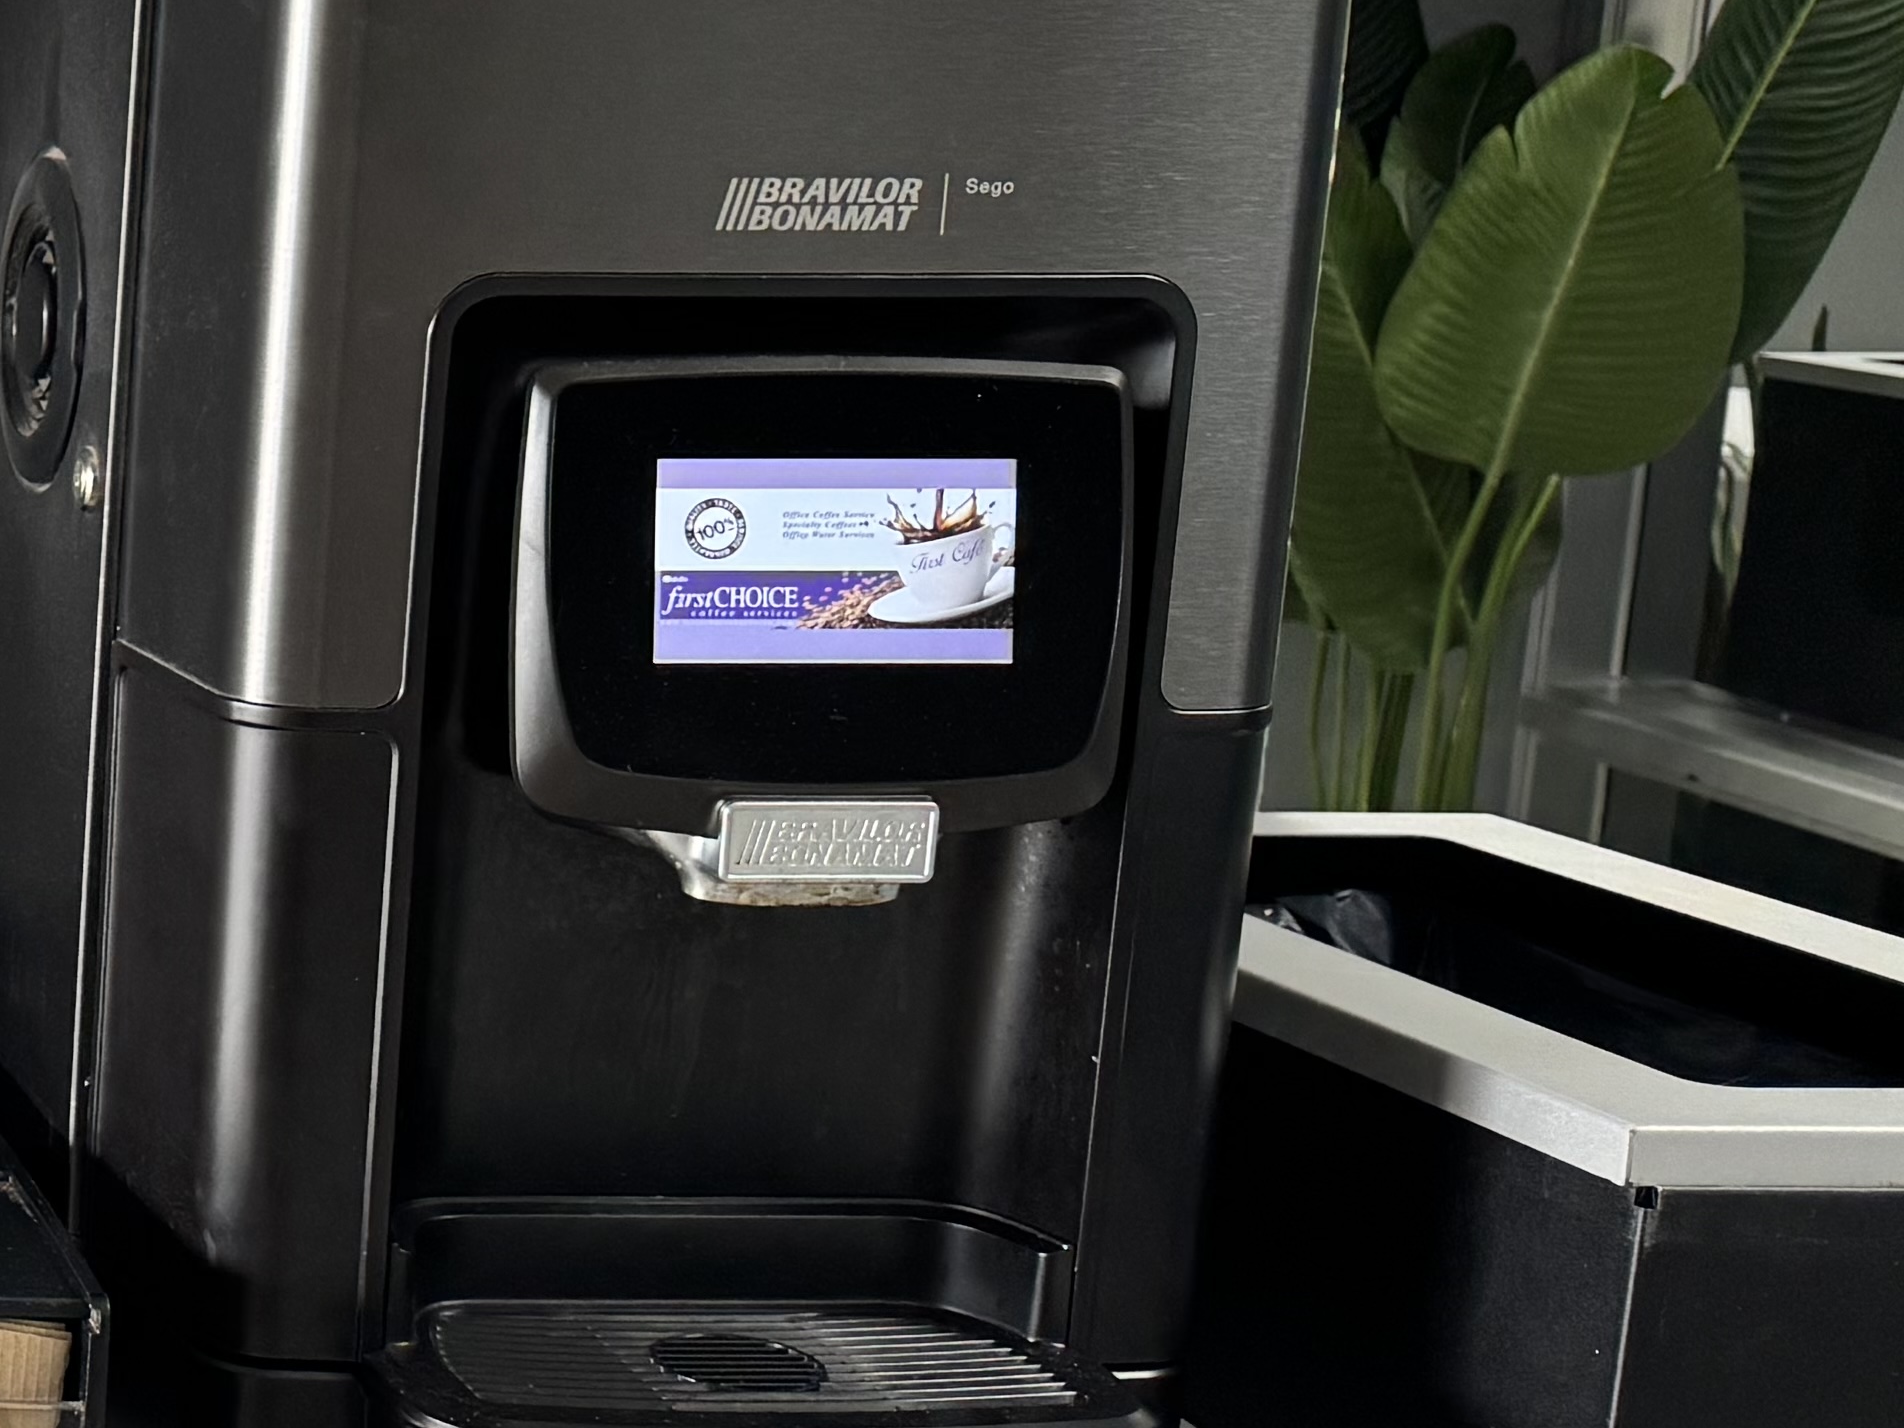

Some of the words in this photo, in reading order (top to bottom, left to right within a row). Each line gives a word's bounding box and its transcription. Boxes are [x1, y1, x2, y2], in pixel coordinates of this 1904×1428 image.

[756, 177, 923, 204] BRAVILOR
[964, 177, 1015, 198] Sego
[747, 205, 919, 232] BONAMAT
